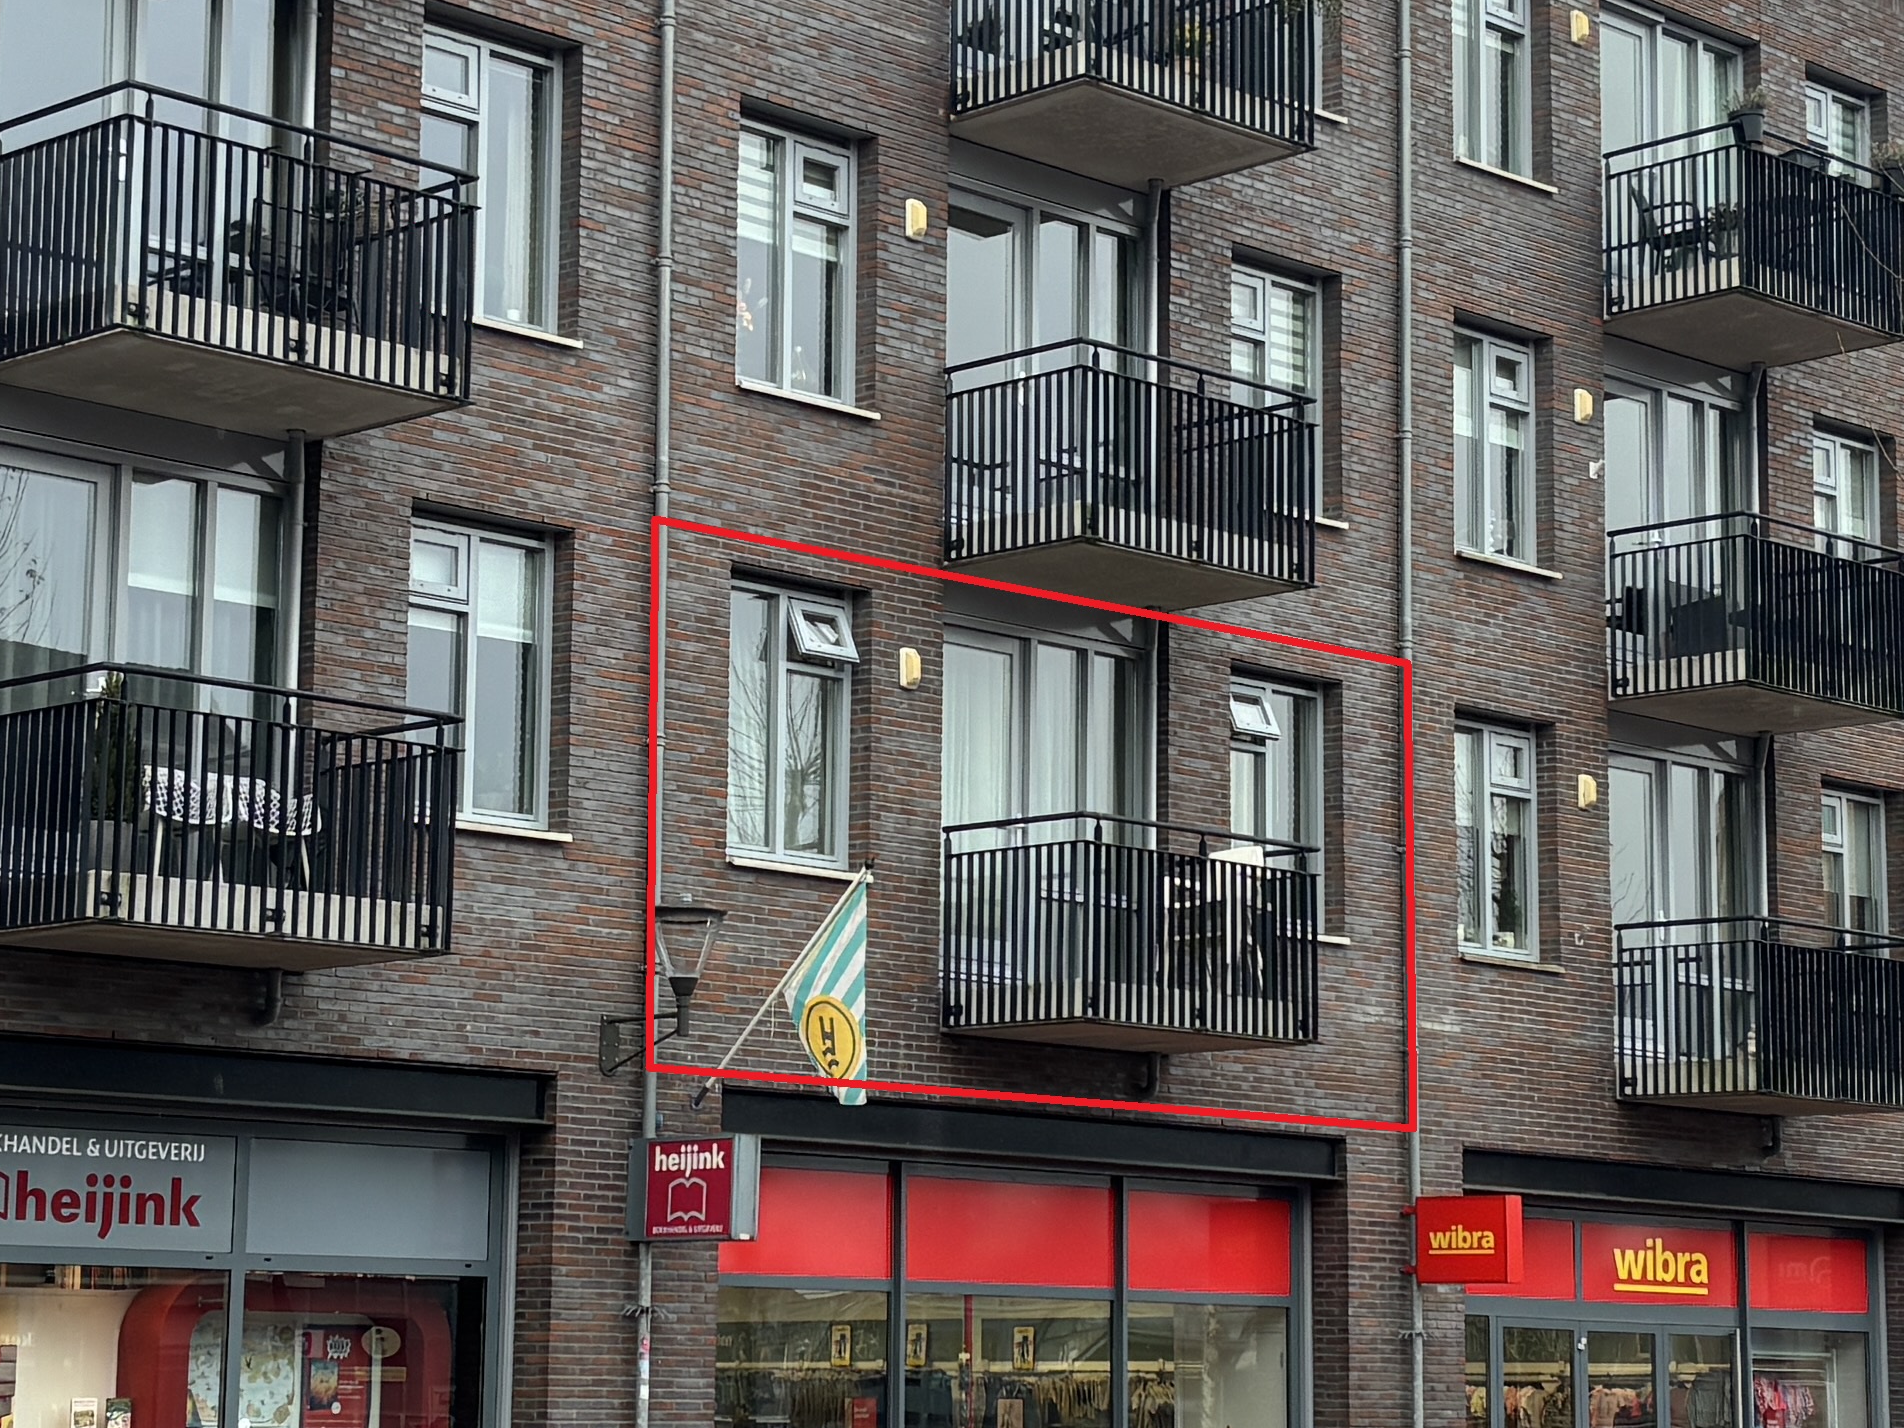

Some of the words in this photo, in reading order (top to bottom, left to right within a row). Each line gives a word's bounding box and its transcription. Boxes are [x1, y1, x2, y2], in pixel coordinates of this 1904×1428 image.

[86, 1138, 100, 1157] &
[104, 1139, 206, 1162] UITGEVERIJ
[654, 1143, 725, 1178] heijink
[14, 1170, 202, 1240] heijink
[1429, 1224, 1495, 1250] wibra
[1613, 1237, 1709, 1284] wibra
